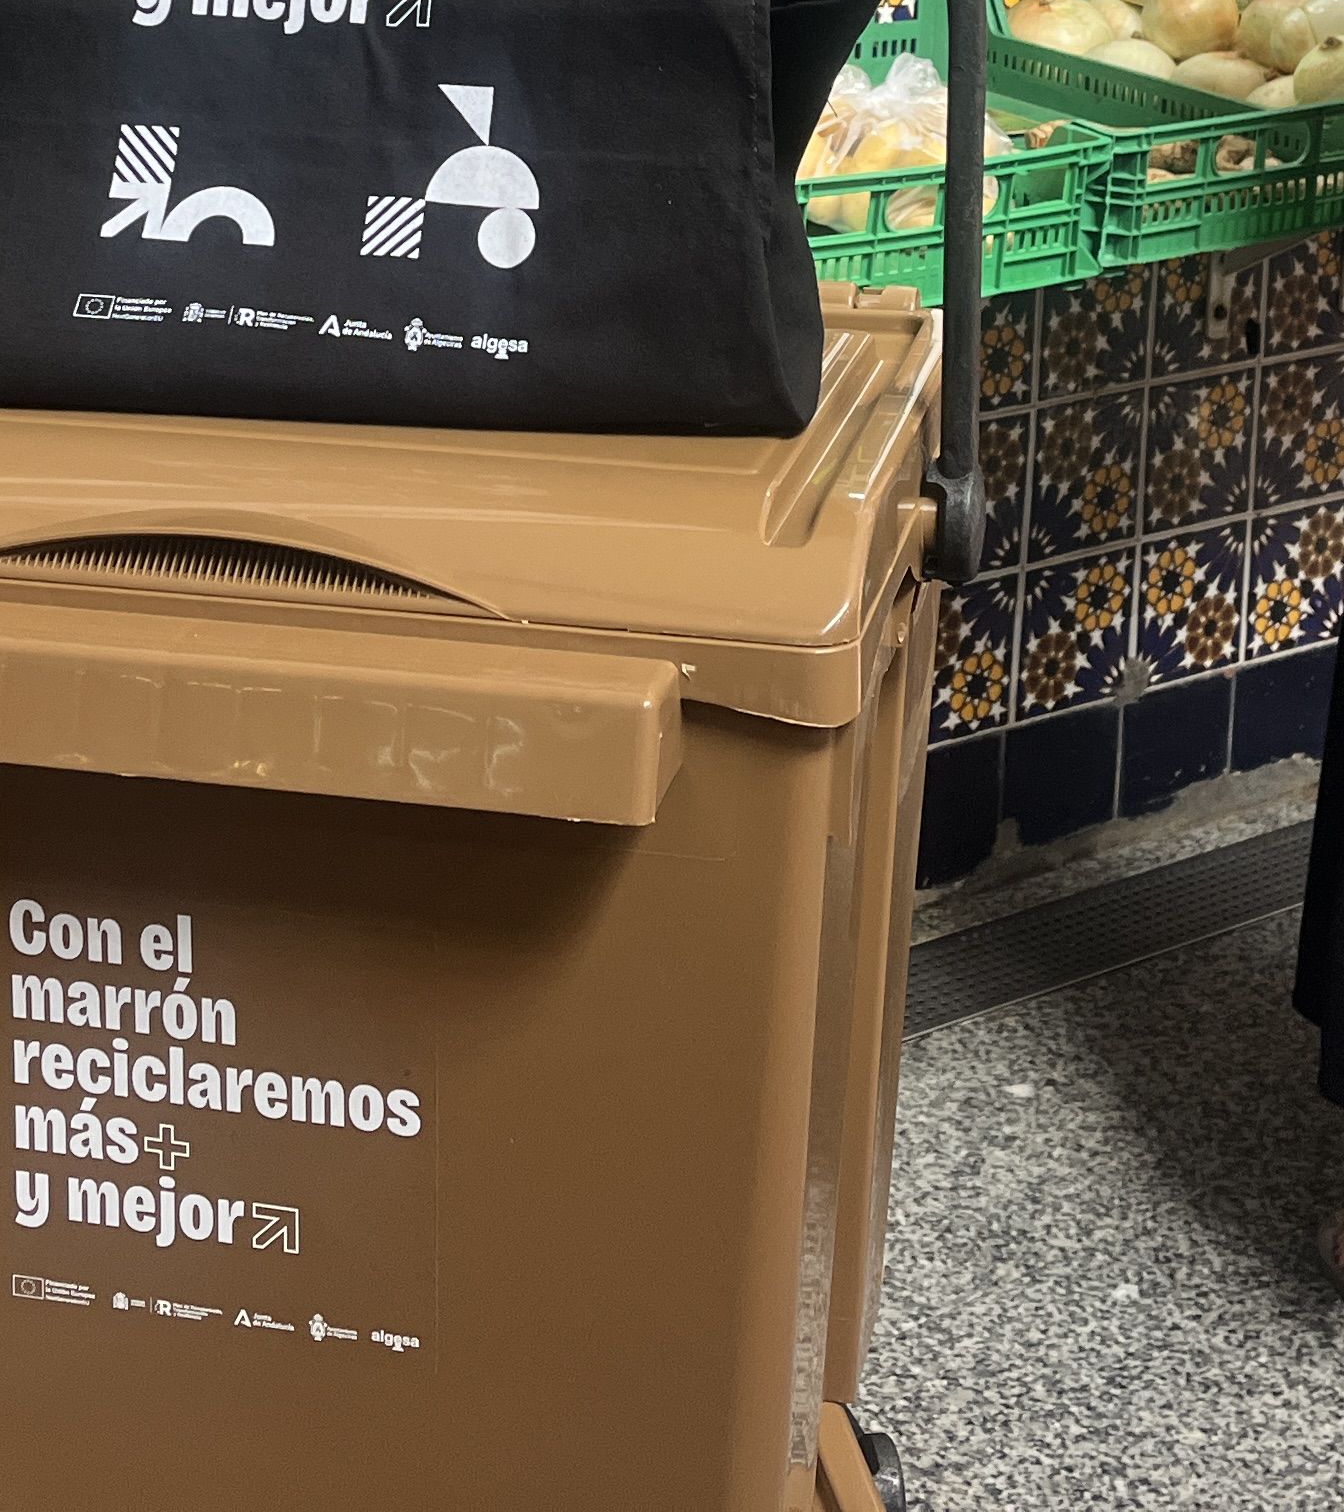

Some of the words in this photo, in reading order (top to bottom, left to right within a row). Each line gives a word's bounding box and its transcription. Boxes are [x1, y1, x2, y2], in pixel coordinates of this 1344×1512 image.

[470, 332, 529, 360] algesa
[8, 898, 123, 965] Con
[139, 913, 193, 974] el
[10, 973, 237, 1046] marrón
[12, 1036, 422, 1138] reciclaremos
[14, 1169, 50, 1229] y
[67, 1175, 245, 1248] mejor
[370, 1329, 421, 1353] algesa
